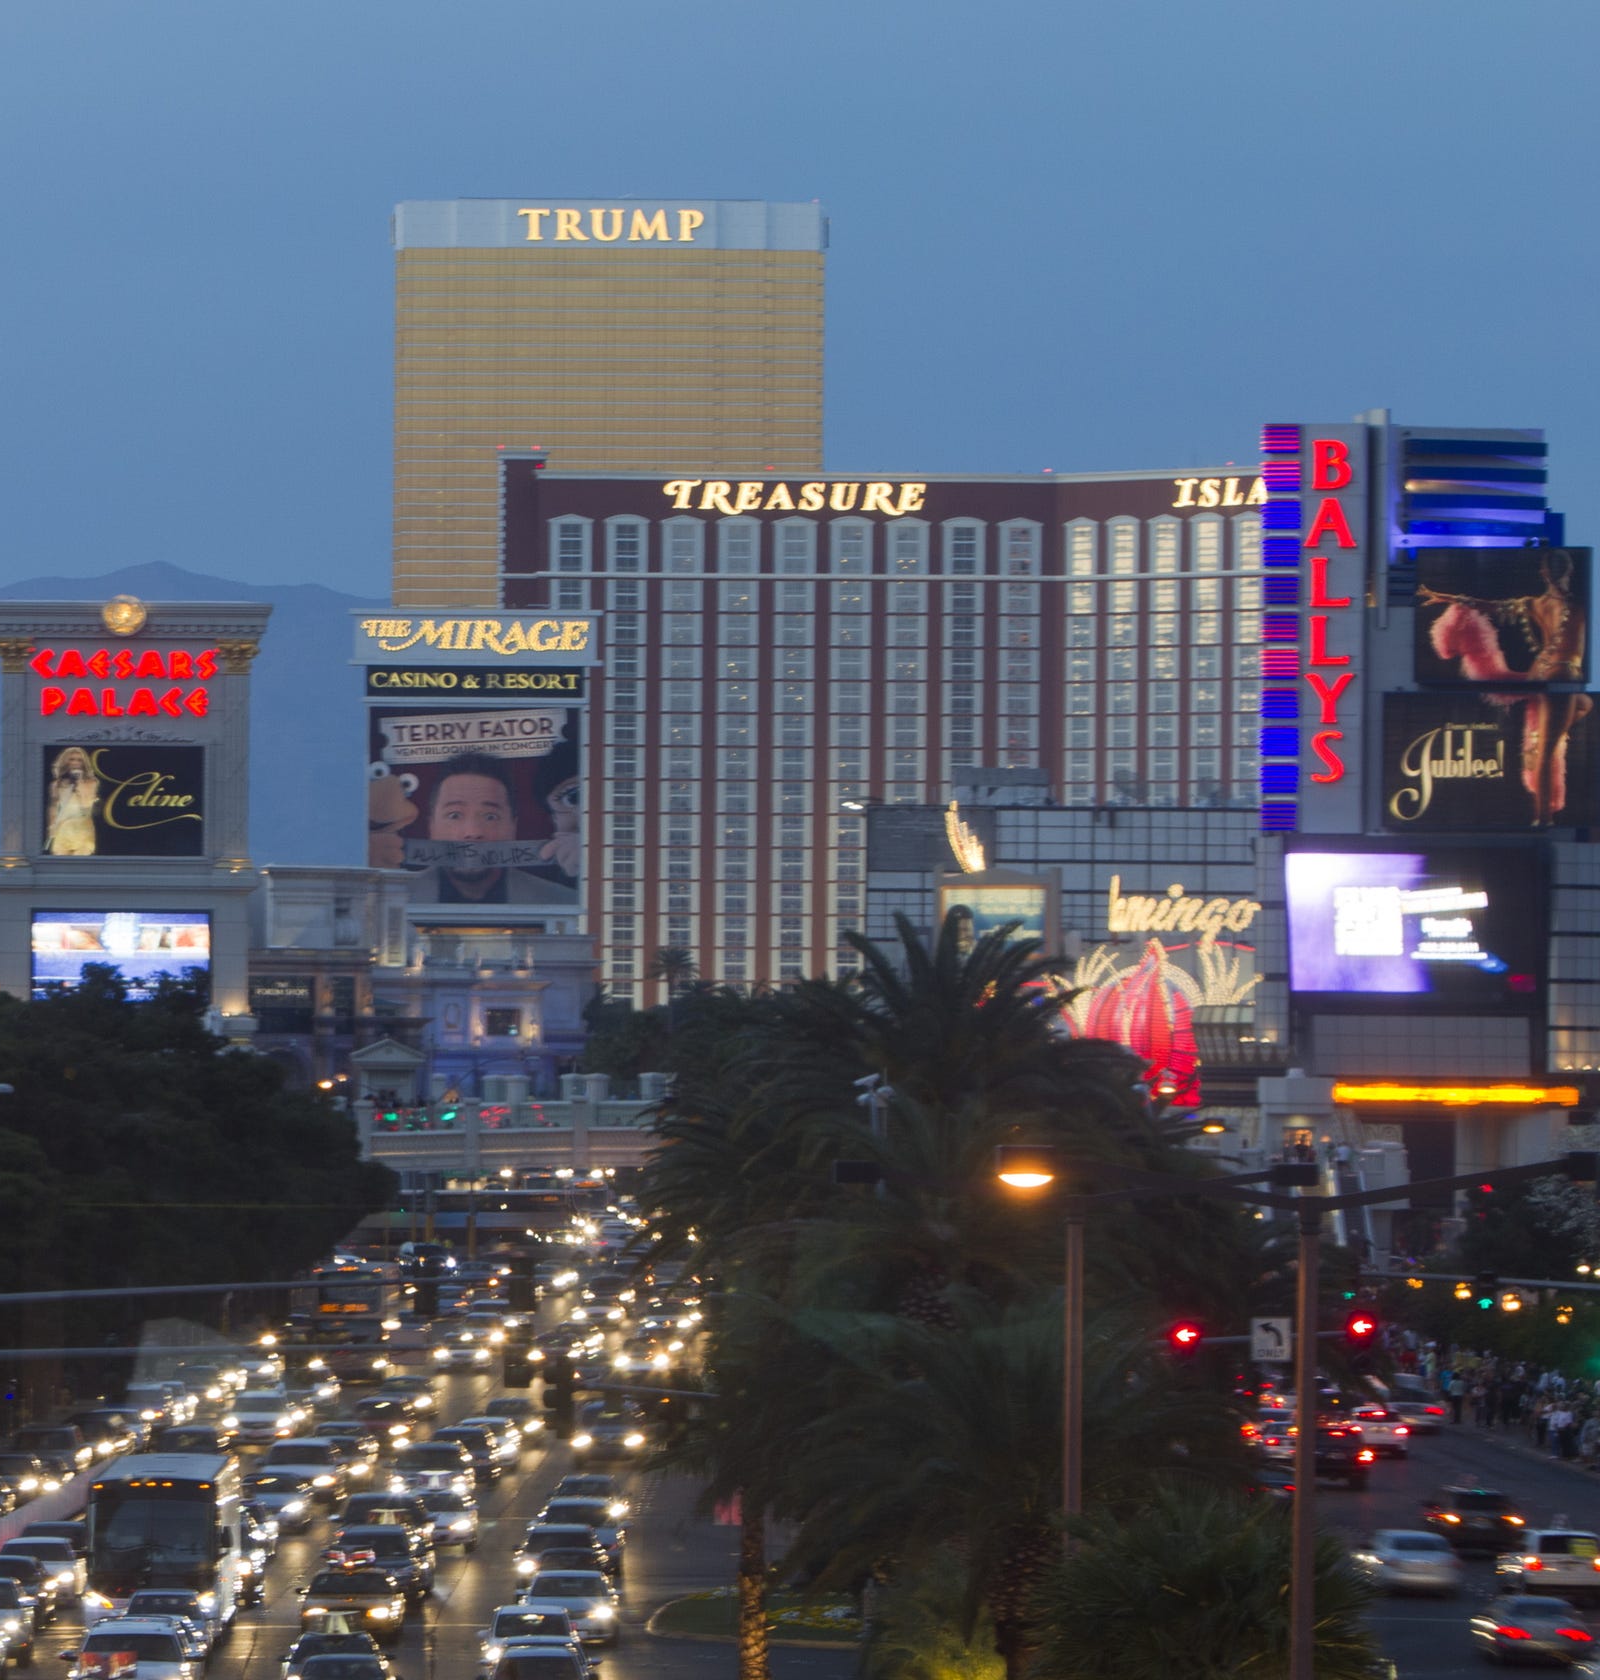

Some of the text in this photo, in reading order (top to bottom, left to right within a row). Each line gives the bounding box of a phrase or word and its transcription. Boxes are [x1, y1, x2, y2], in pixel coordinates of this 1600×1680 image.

[517, 208, 705, 242] TRUMP
[662, 479, 928, 516] TREASURE
[1304, 439, 1357, 783] BALLYS
[361, 619, 591, 655] THE MIRAGE
[29, 648, 219, 681] CAESARS
[369, 672, 580, 690] CASINO & RESORT
[40, 686, 210, 718] PALACE
[393, 717, 554, 743] TERRY FATOR
[395, 745, 487, 757] VENTRILOQUISM
[90, 748, 203, 830] Celine
[1389, 727, 1505, 820] Jubilee!
